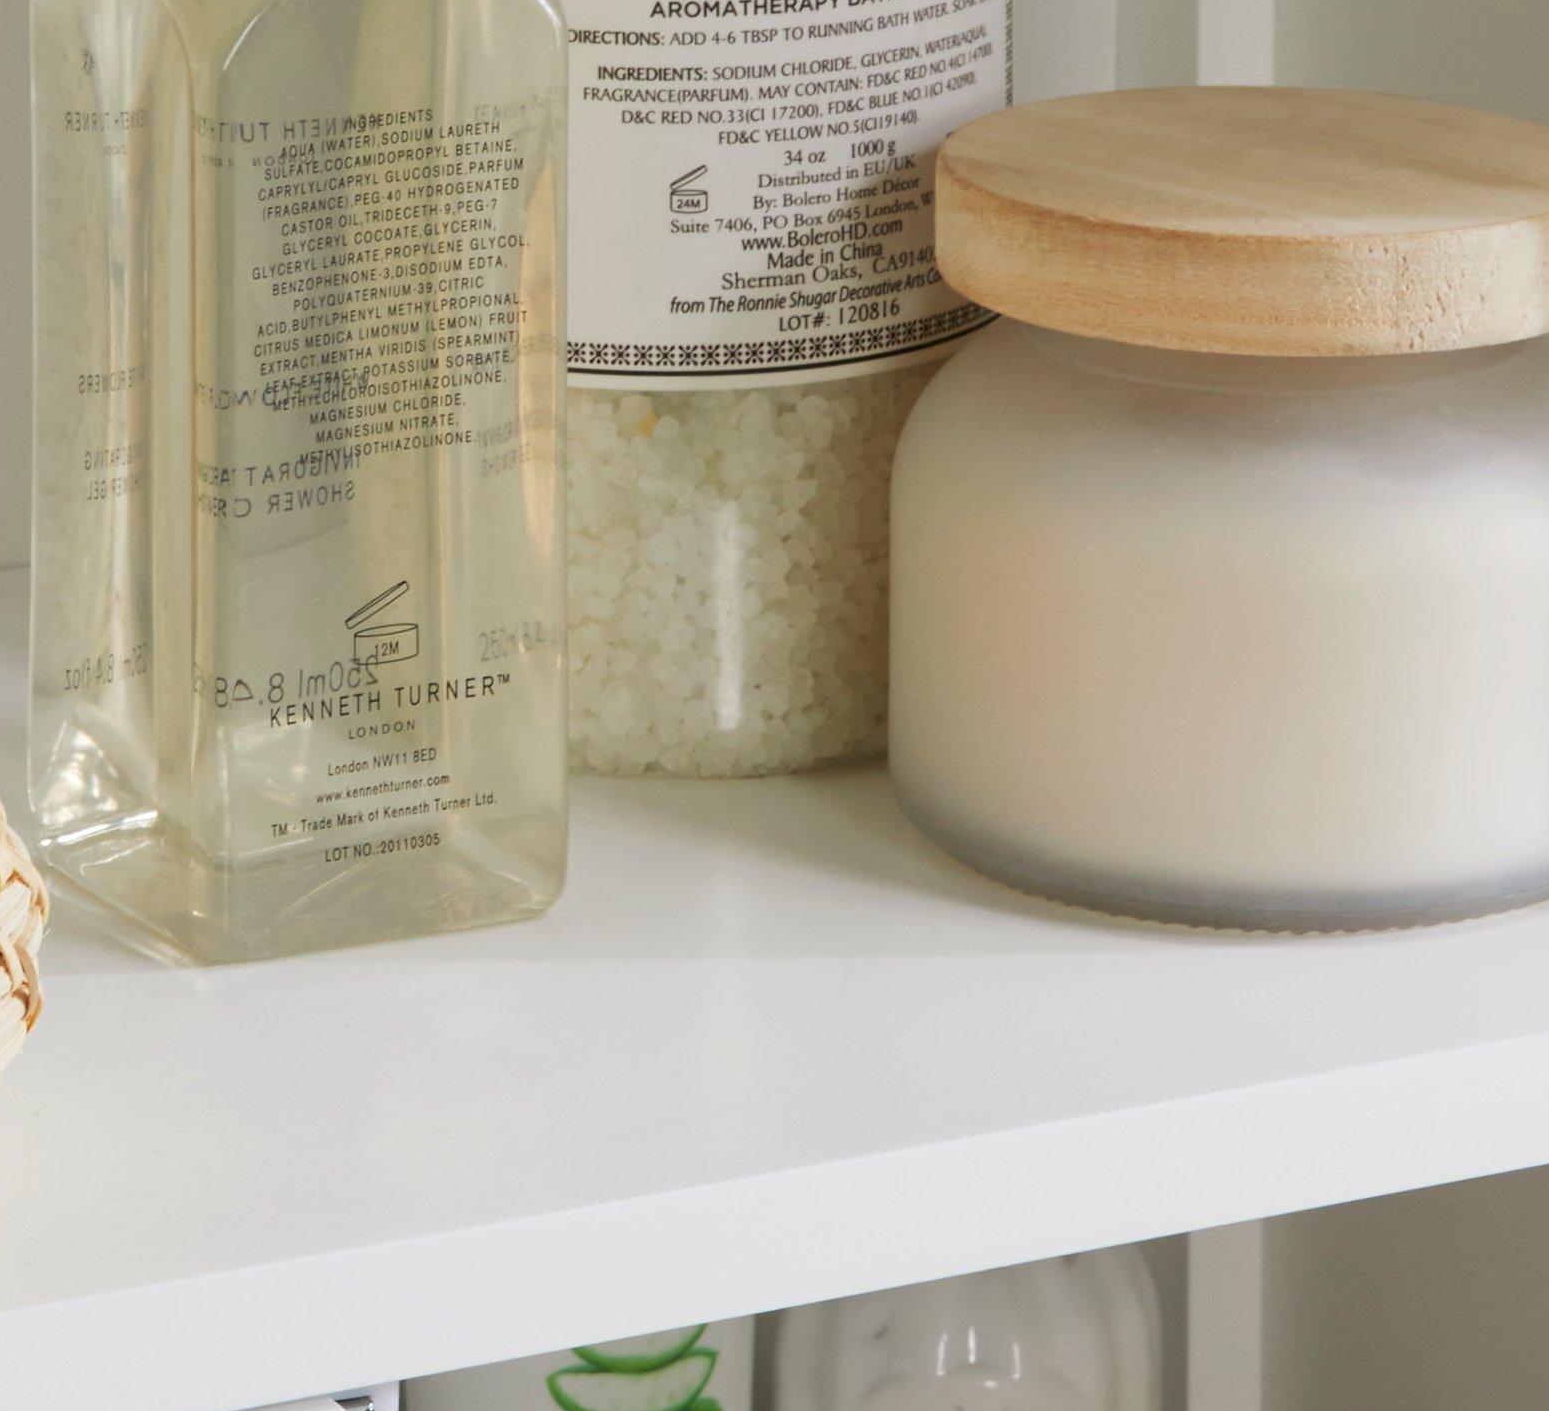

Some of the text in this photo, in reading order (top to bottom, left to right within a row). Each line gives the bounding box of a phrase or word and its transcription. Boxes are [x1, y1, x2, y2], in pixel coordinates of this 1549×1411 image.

[670, 32, 706, 46] ADD
[711, 31, 737, 45] 4-6
[742, 28, 778, 44] TBSP
[784, 27, 804, 41] TO
[808, 17, 874, 39] RUNNING
[878, 11, 909, 30] BATH
[598, 66, 707, 82] INGREDIENTS:
[712, 65, 776, 80] SODIUM
[758, 83, 791, 100] MAY
[795, 77, 864, 97] CONTAIN:
[867, 69, 901, 89] FD&C
[904, 63, 927, 80] RED
[343, 108, 434, 133] INGREDIENTS
[621, 110, 657, 124] D&C
[661, 110, 692, 124] RED
[697, 108, 765, 125] NO.33(CI
[828, 97, 865, 115] FD&C
[869, 92, 899, 109] BLUE
[280, 121, 501, 159] AQUA LAURETH
[718, 130, 761, 145] FD&C
[765, 124, 824, 143] YELLOW
[783, 140, 897, 166] 34 oz 1000 g
[758, 153, 916, 189] Distributed in EU/UK
[258, 174, 379, 201] CAPRYLYL/CAPRYL
[408, 177, 520, 199] HYDROGENATED
[753, 195, 777, 212] By:
[783, 190, 831, 209] Bolero
[837, 182, 879, 203] Home
[670, 195, 919, 234] Suite 7406, PO Box 6945 London,
[676, 198, 701, 209] 24M
[281, 217, 333, 236] CASTOR
[741, 219, 903, 250] www.BoleroHD.com
[282, 235, 348, 256] GLYCERYL
[767, 242, 883, 269] Made in China
[252, 261, 317, 280] GLYCERYL
[721, 247, 936, 290] Sherman Oaks, CA9140
[670, 271, 926, 314] from The Ronnie Shugar Decorative Arts
[778, 298, 901, 332] LOT#: 120816
[254, 310, 528, 358] CITRUS MEDICA LIMONUM (LEMON) FRUIT
[378, 339, 427, 357] VIRIDIS
[432, 329, 521, 351] (SPEARMINT)
[309, 403, 387, 425] MAGNESIUM
[315, 421, 394, 443] MAGNESIUM
[374, 640, 399, 657] 12M
[269, 691, 381, 728] KENNETH
[348, 719, 416, 739] LONDON
[328, 747, 437, 777] London NW11 8ED
[315, 773, 450, 804] www.kennethturner.com
[271, 792, 498, 837] TM Trade Mark of Kenneth Turner Ltd.
[324, 848, 350, 863] LOT
